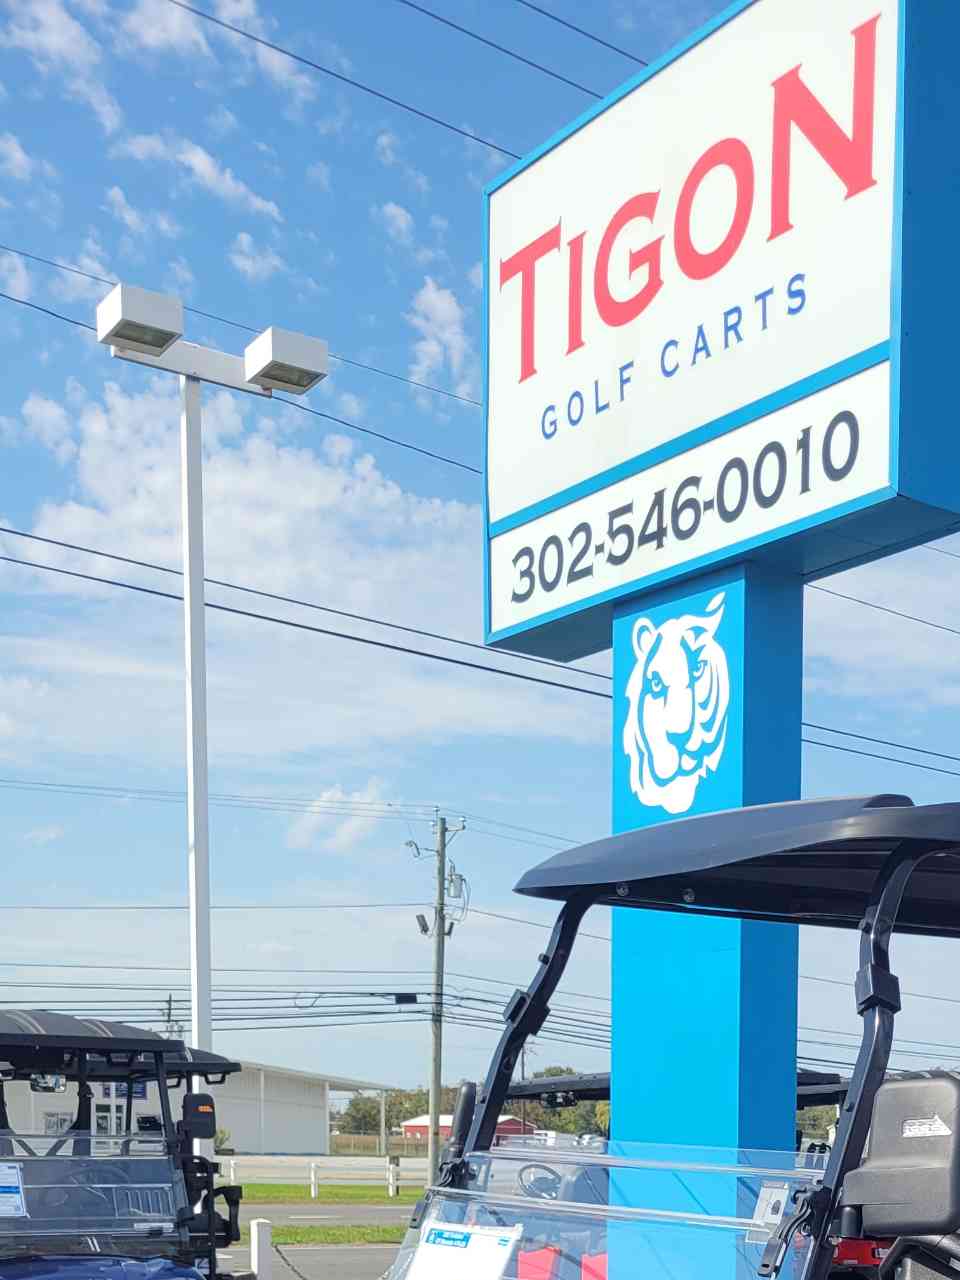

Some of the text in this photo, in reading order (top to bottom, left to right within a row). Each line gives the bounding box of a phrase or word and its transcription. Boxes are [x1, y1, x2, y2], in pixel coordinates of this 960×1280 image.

[500, 13, 882, 384] TIGON
[540, 273, 808, 440] GOLF CARTS
[510, 410, 860, 603] 302-546-0010
